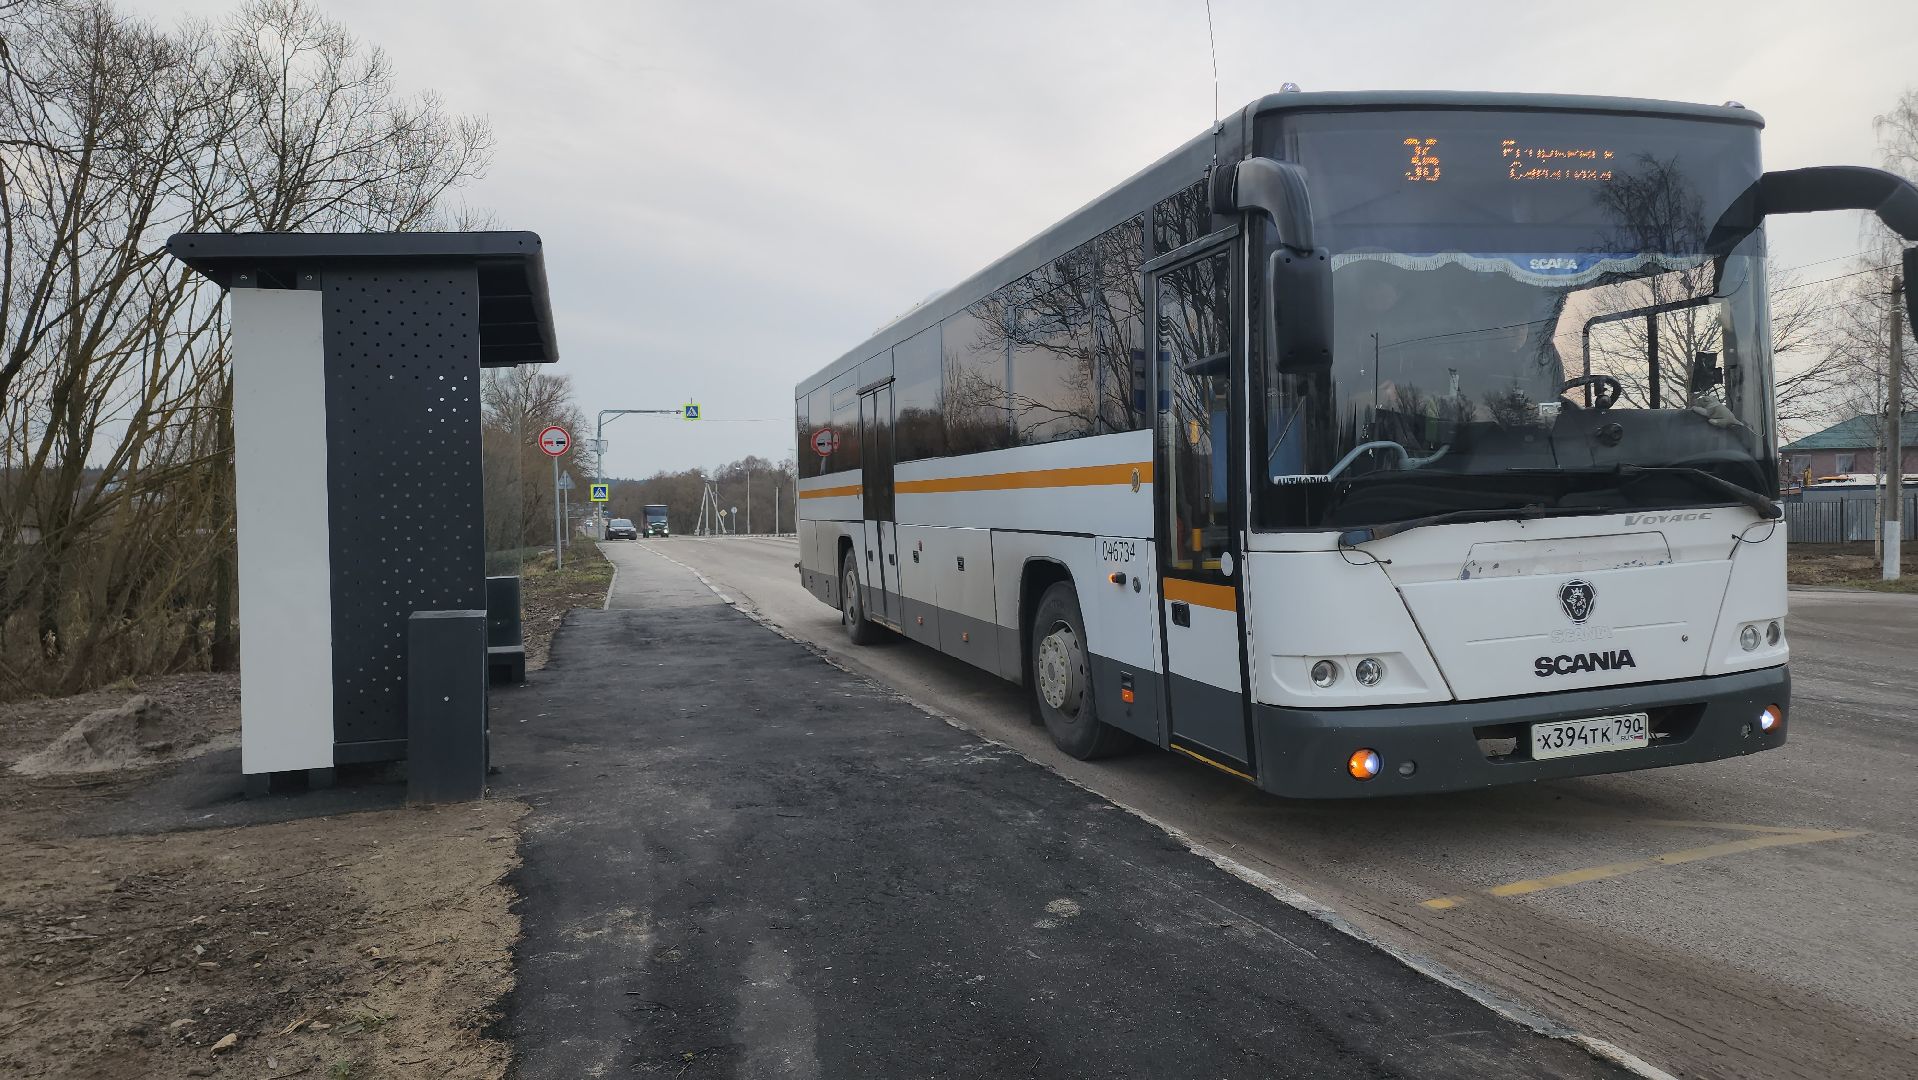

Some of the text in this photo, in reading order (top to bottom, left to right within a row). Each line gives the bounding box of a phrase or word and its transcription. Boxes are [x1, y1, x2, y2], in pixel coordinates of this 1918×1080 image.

[1403, 138, 1440, 181] 36
[1102, 540, 1136, 562] 046734
[1534, 649, 1636, 677] SCANIA
[1614, 718, 1643, 736] 790
